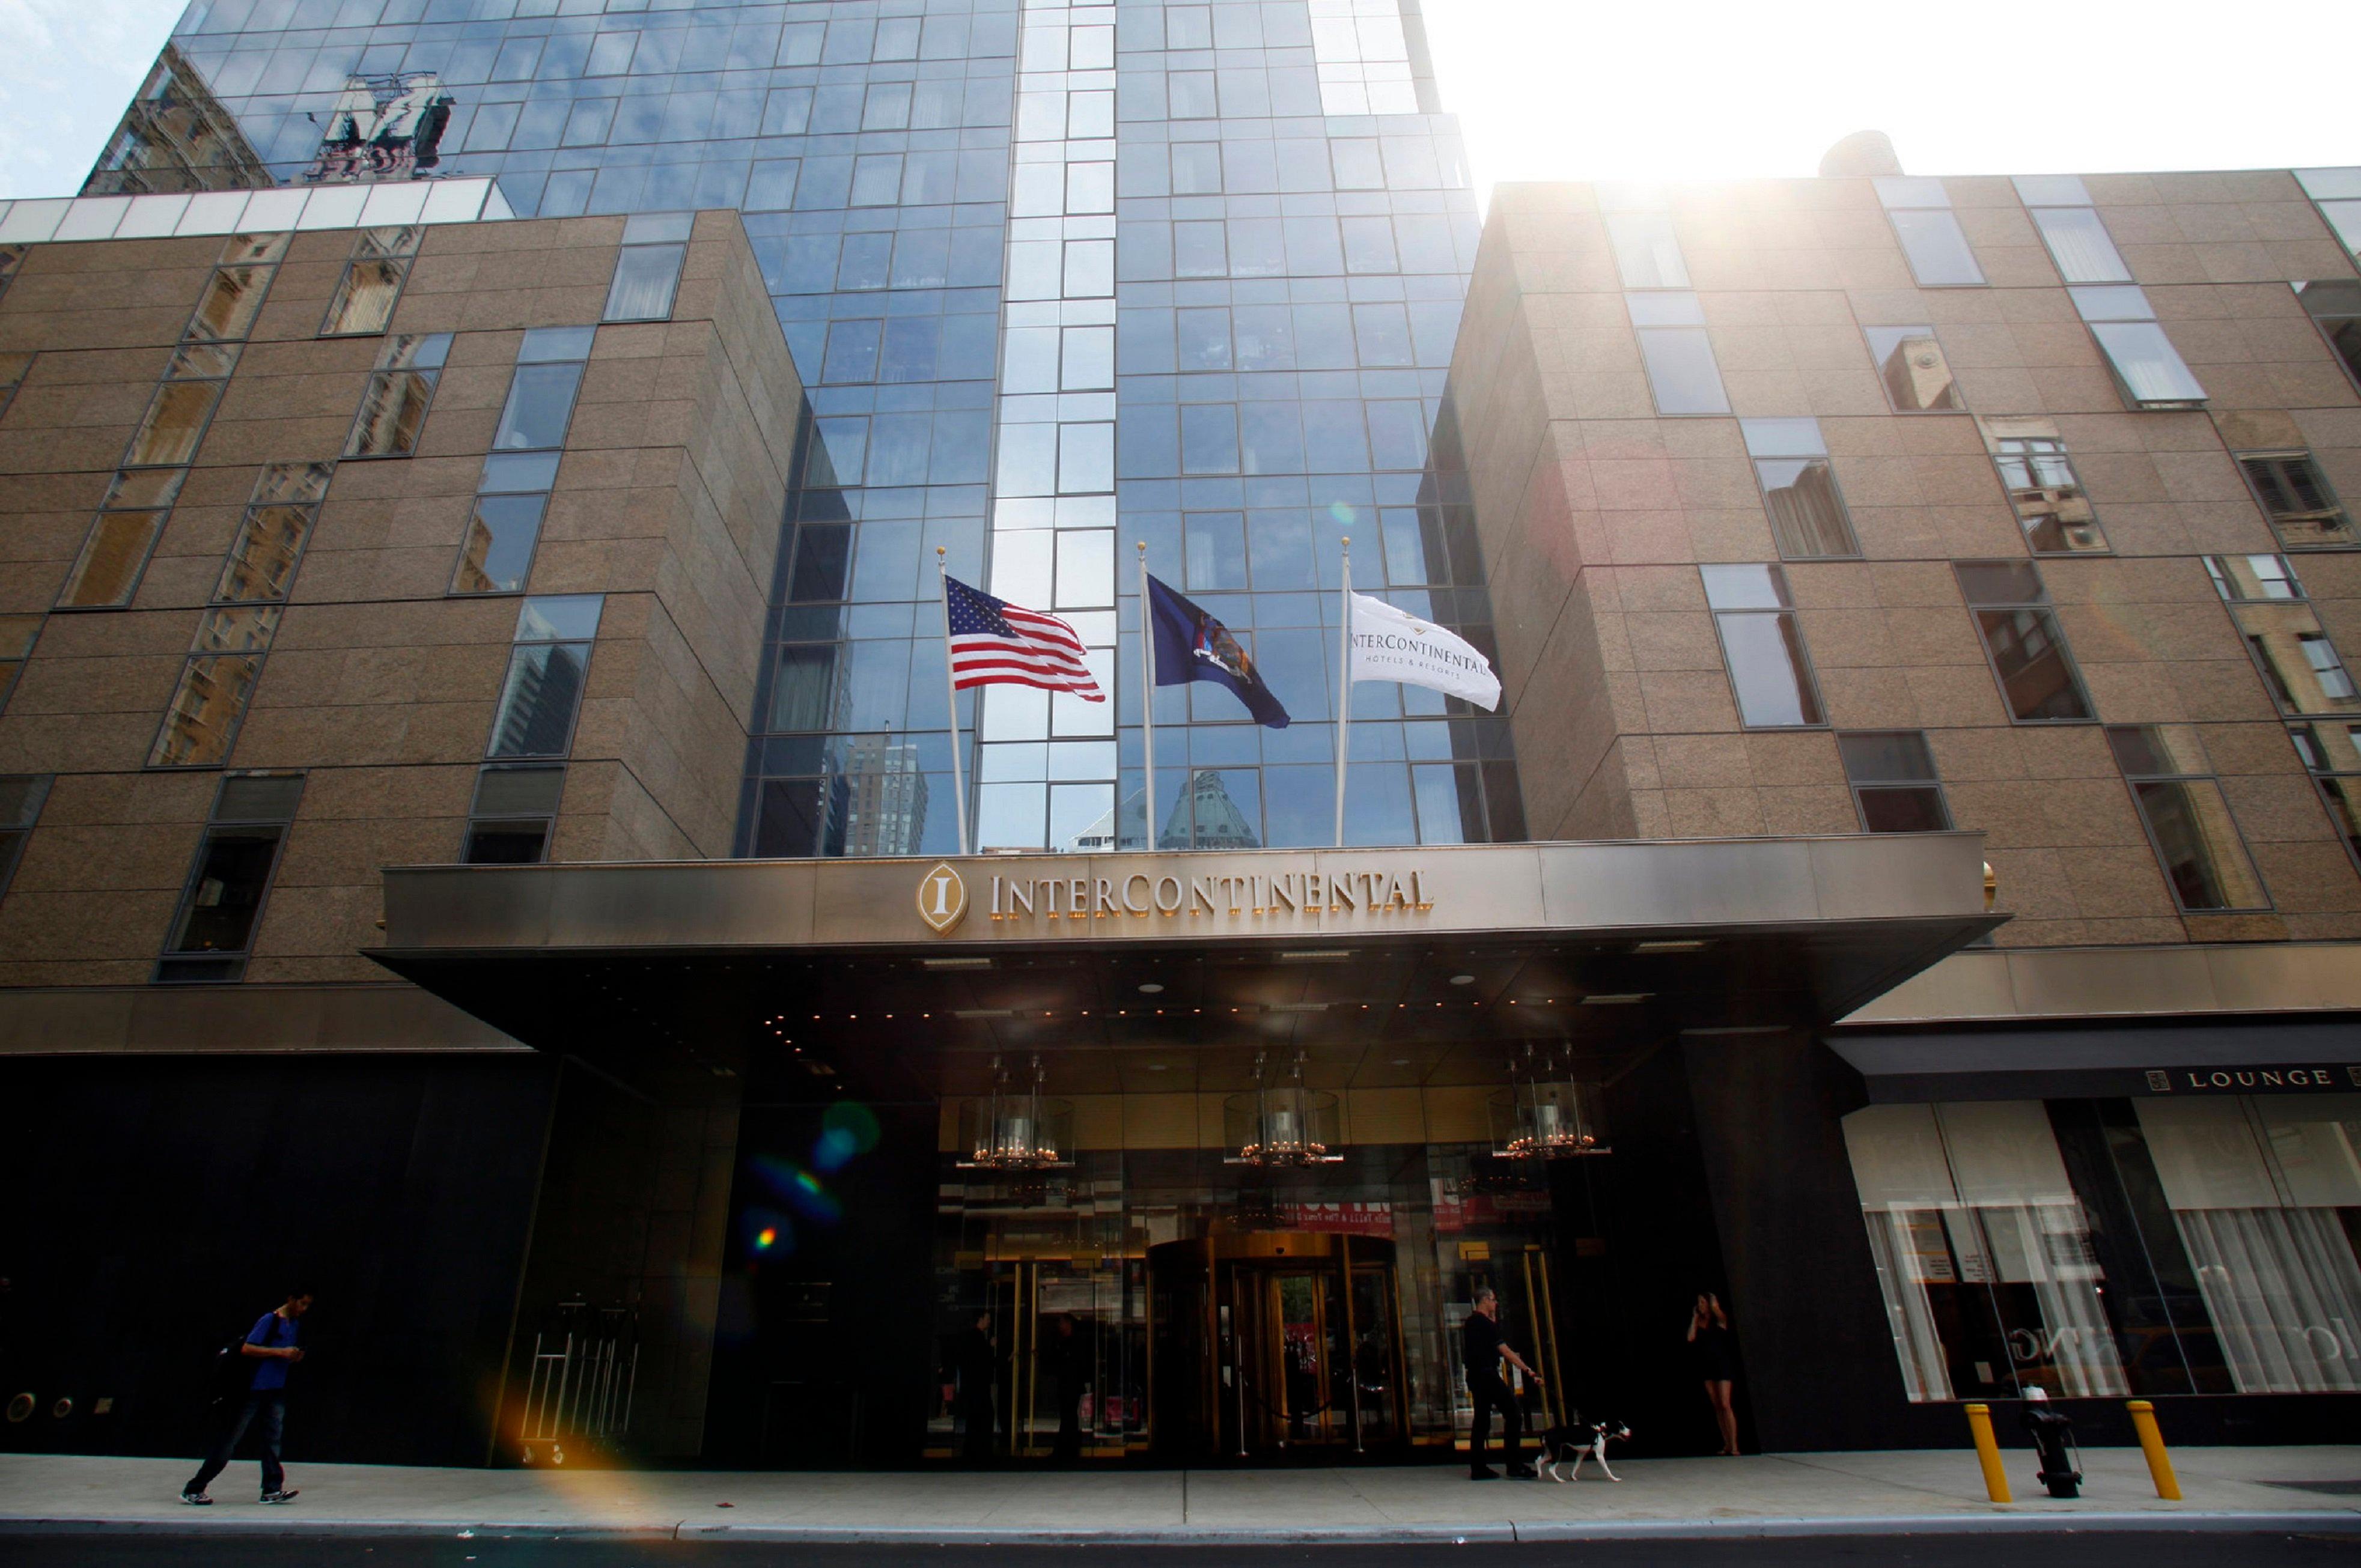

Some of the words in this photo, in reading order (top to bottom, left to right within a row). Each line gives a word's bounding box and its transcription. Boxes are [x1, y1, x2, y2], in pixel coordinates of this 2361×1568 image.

[1366, 655, 1403, 664] HOTELS
[1419, 661, 1460, 679] RESORTS
[931, 877, 952, 914] I
[990, 871, 1434, 917] INTERCONTINENTAL
[2187, 1069, 2332, 1088] LOUNGE
